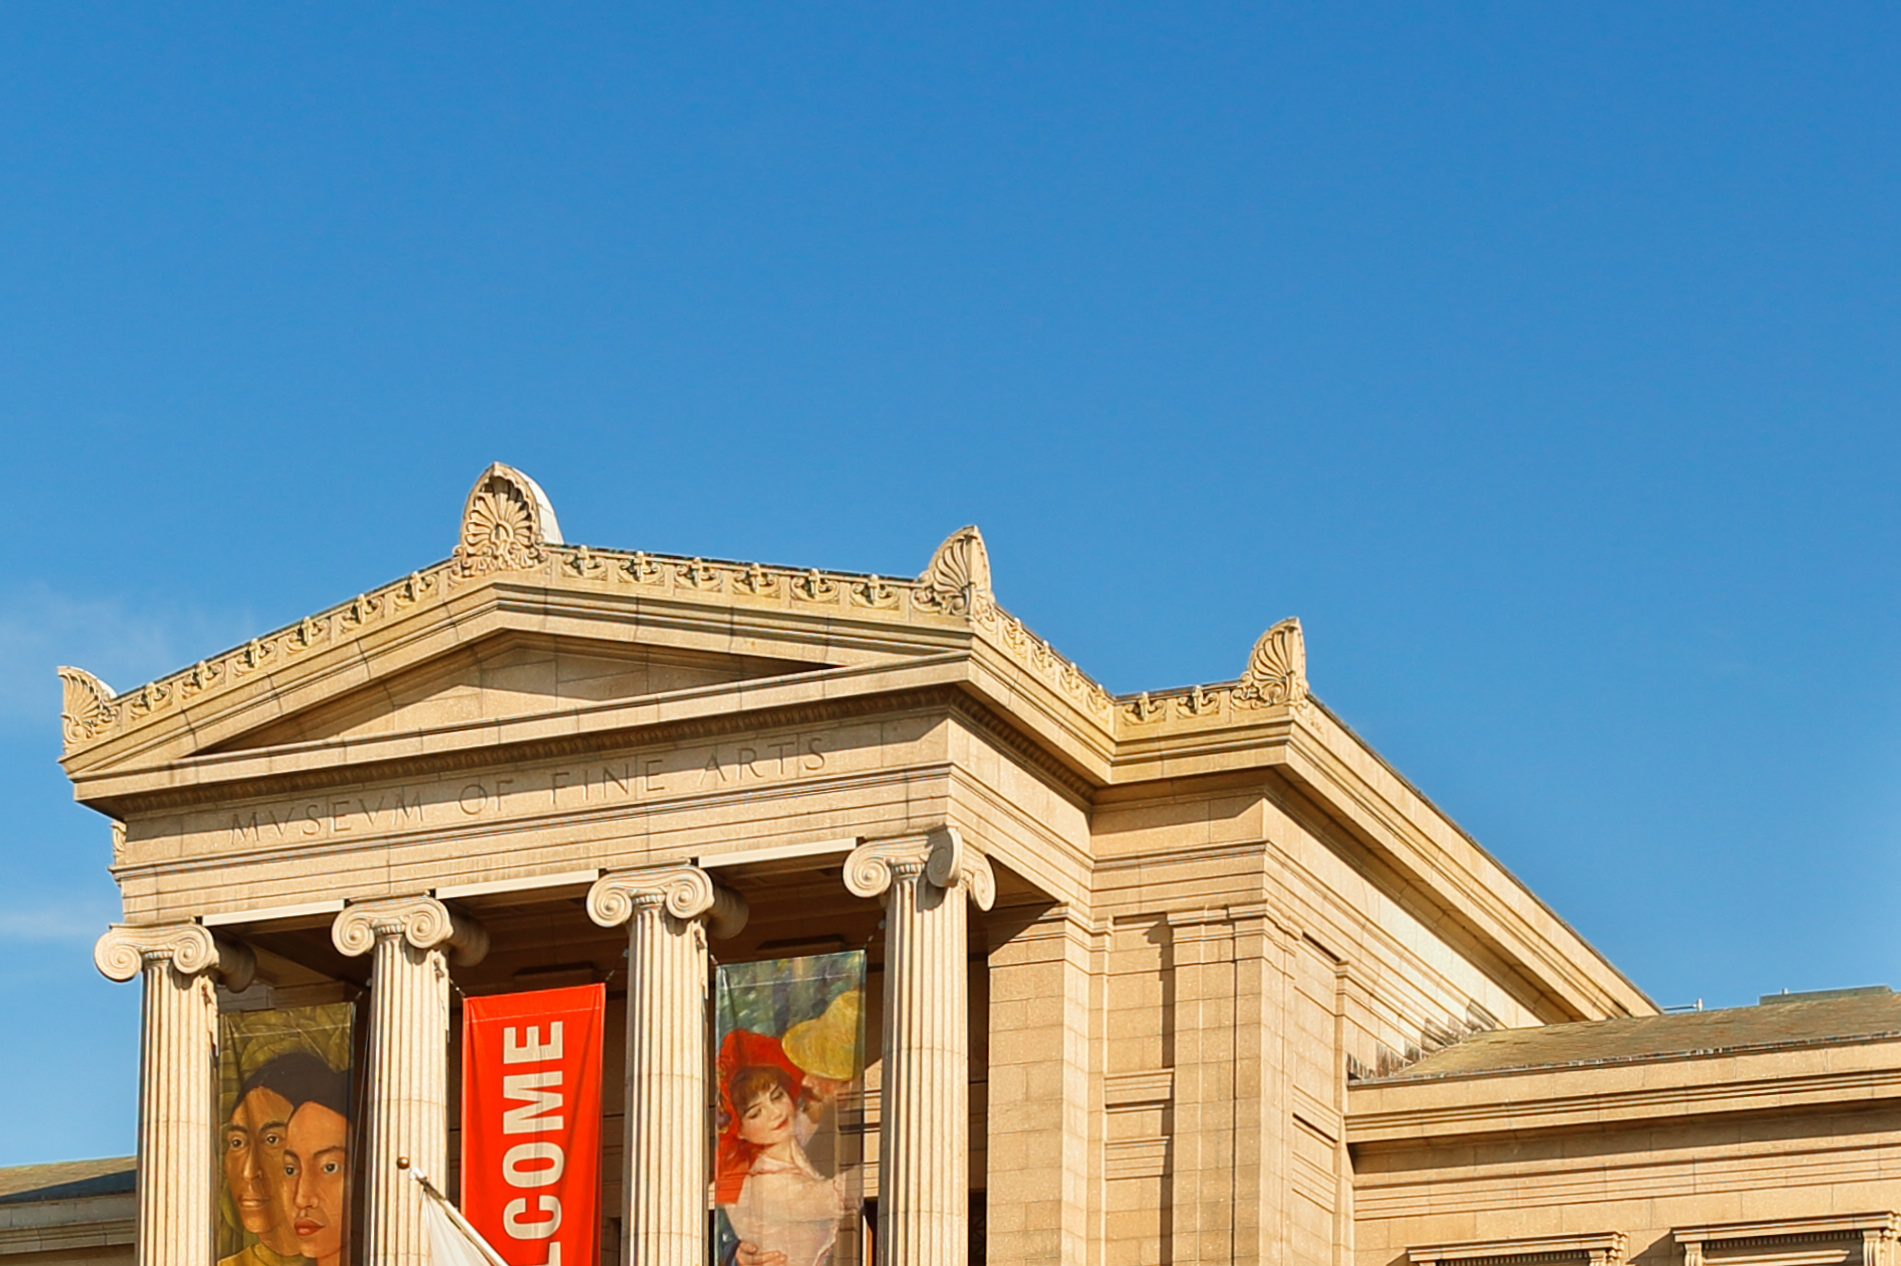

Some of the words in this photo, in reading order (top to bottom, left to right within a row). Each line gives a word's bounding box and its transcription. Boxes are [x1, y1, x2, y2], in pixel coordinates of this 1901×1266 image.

[458, 779, 514, 816] OF
[550, 758, 666, 805] FINE
[698, 737, 826, 786] ARTS
